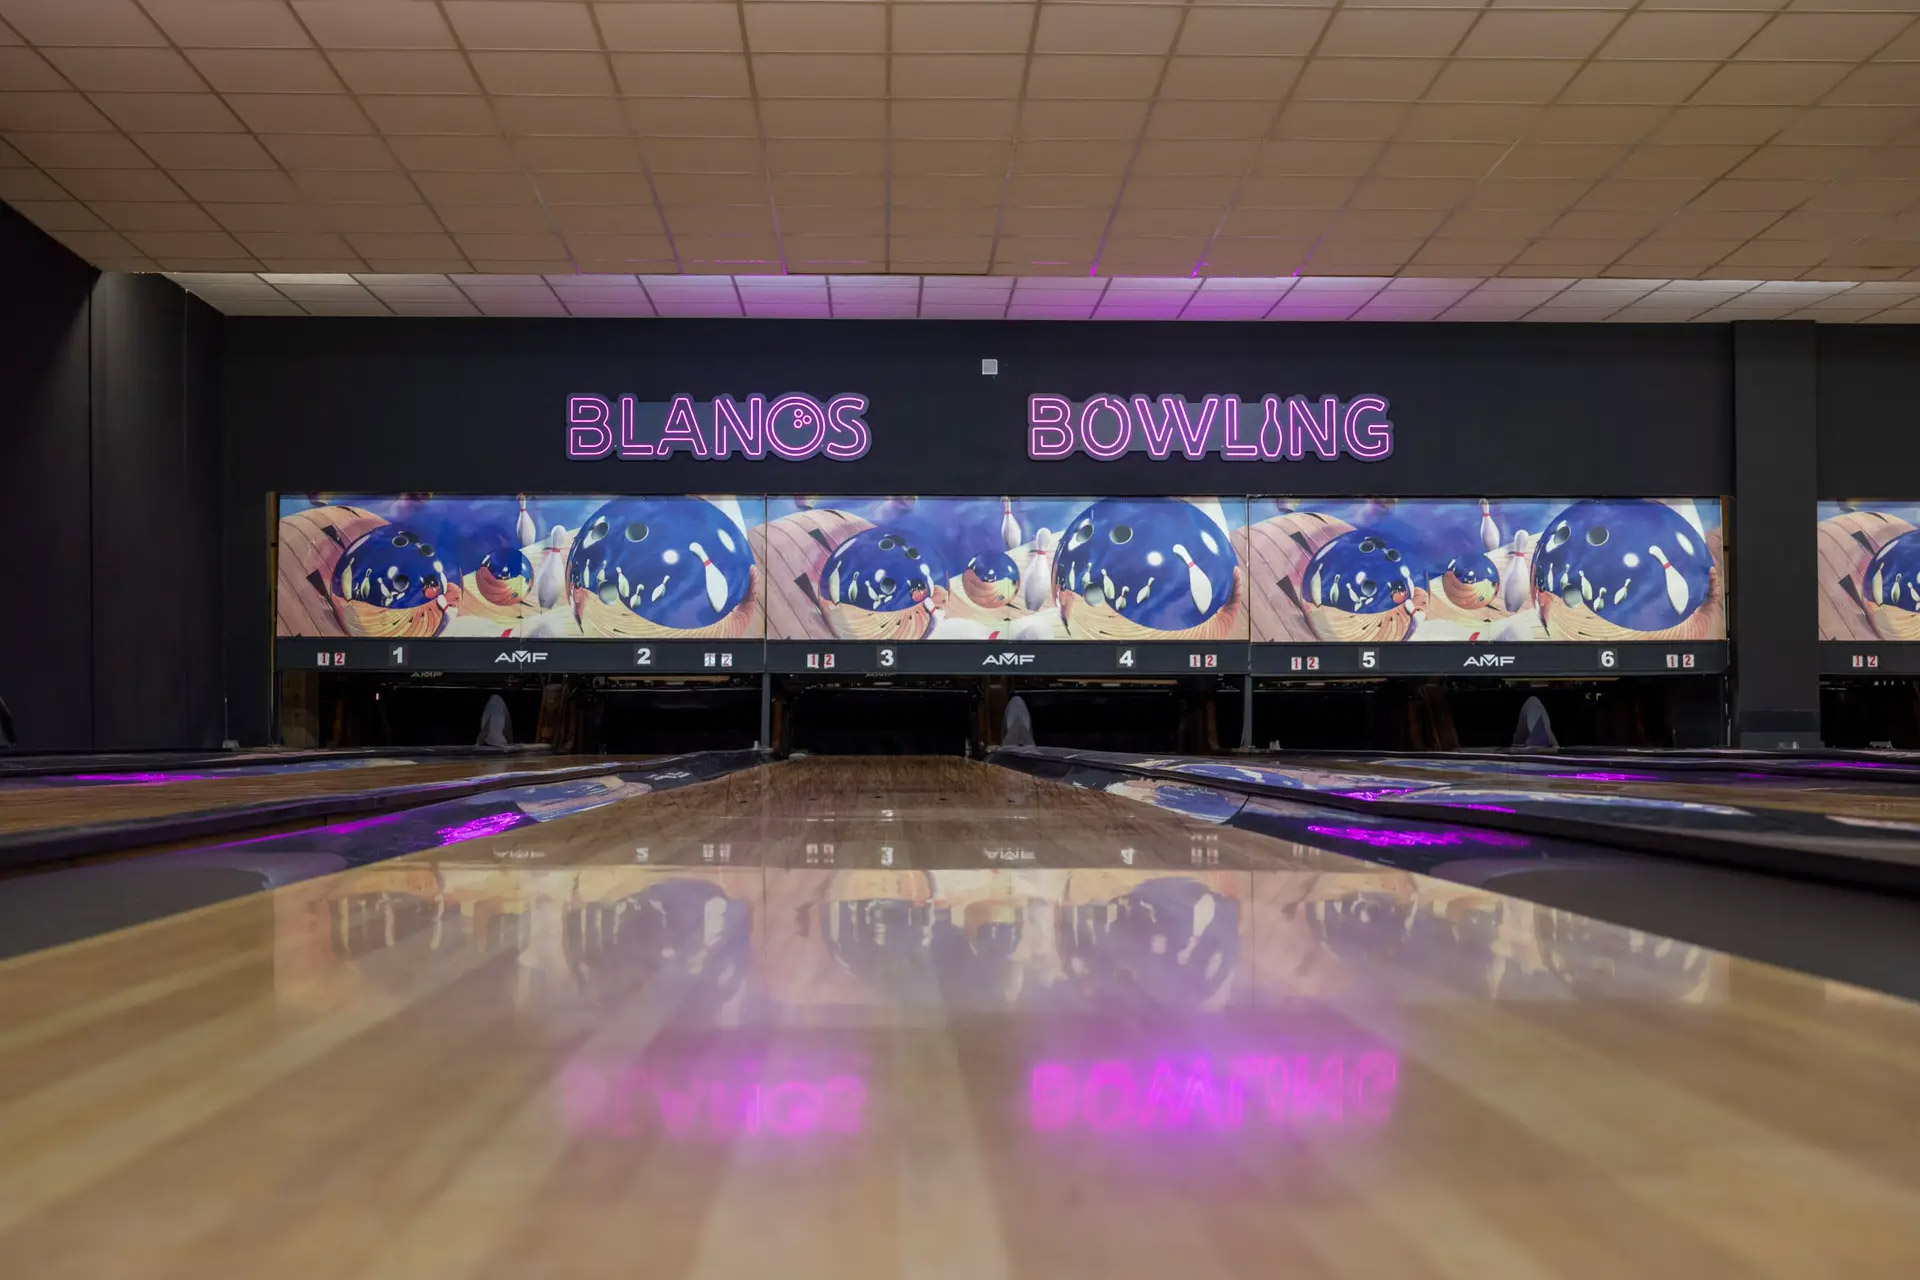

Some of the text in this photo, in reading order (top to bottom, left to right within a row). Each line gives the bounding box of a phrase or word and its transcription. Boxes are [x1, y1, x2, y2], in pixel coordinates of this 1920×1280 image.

[569, 396, 1390, 459] BLANOS BOWLING
[392, 646, 403, 664] 1
[494, 650, 548, 663] AMF
[636, 648, 651, 665] 2
[880, 649, 894, 666] 3
[982, 652, 1035, 665] AMF
[1119, 650, 1134, 667] 4
[1362, 651, 1376, 668] 5
[1463, 654, 1516, 667] AMF
[1601, 650, 1615, 667] 6
